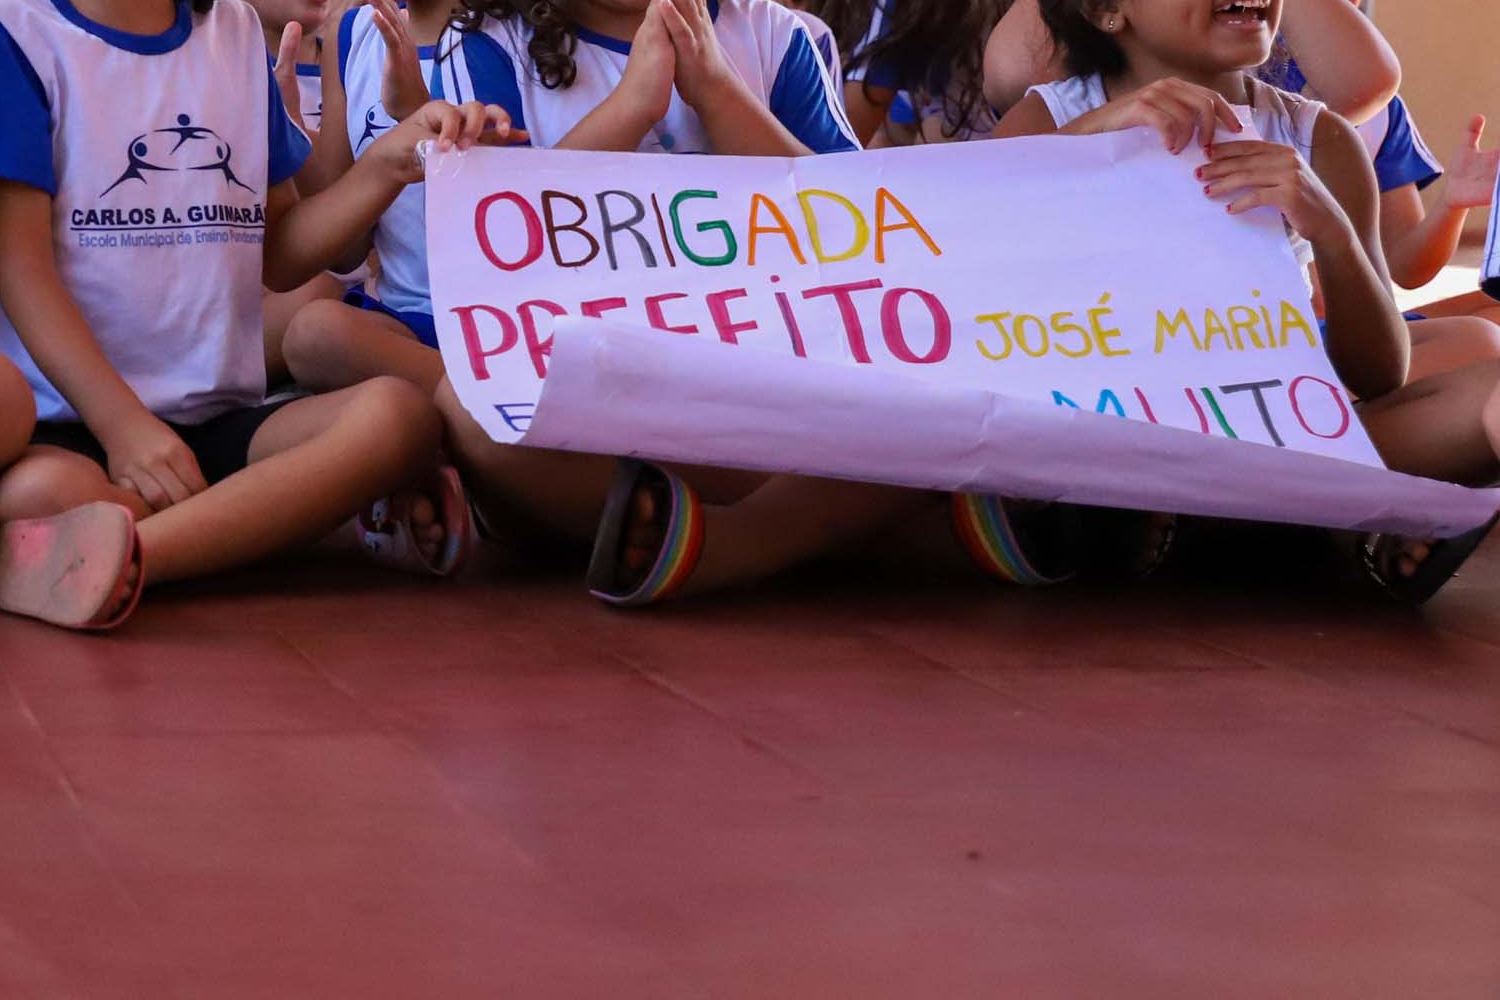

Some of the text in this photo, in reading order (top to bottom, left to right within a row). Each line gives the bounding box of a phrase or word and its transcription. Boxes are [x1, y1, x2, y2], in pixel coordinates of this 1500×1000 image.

[72, 203, 266, 226] CARLOS A. GUIMARÃ
[474, 187, 943, 272] OBRIGADA
[78, 232, 117, 248] Escola
[120, 230, 175, 249] Municipal
[176, 231, 193, 245] de
[195, 229, 229, 244] Ensino
[974, 291, 1132, 361] JOSÉ
